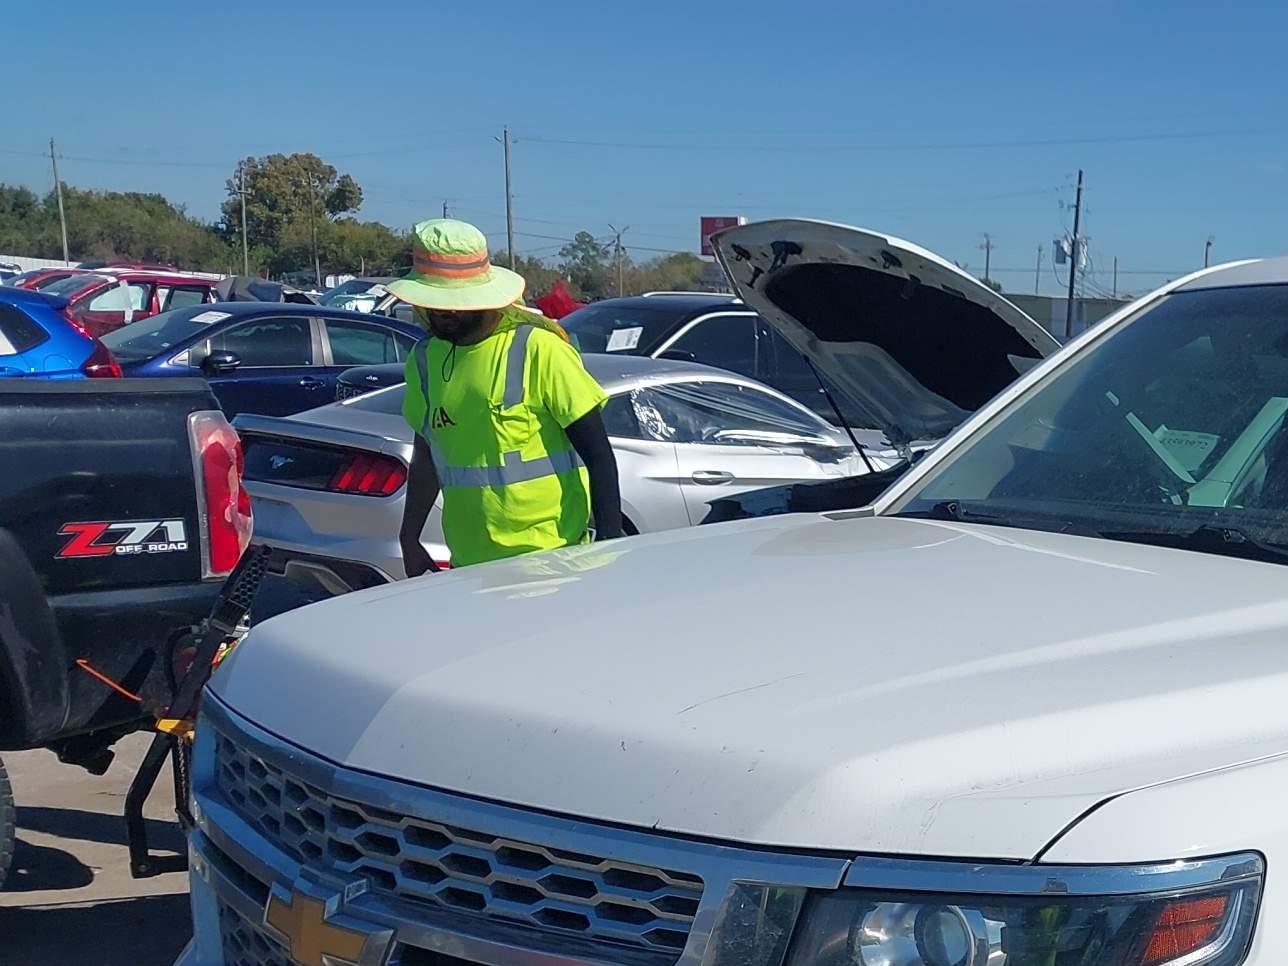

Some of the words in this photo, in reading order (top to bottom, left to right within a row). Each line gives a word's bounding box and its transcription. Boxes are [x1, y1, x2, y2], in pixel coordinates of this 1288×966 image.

[55, 519, 185, 557] Z71
[115, 544, 144, 554] OFF
[148, 542, 188, 552] ROAD
